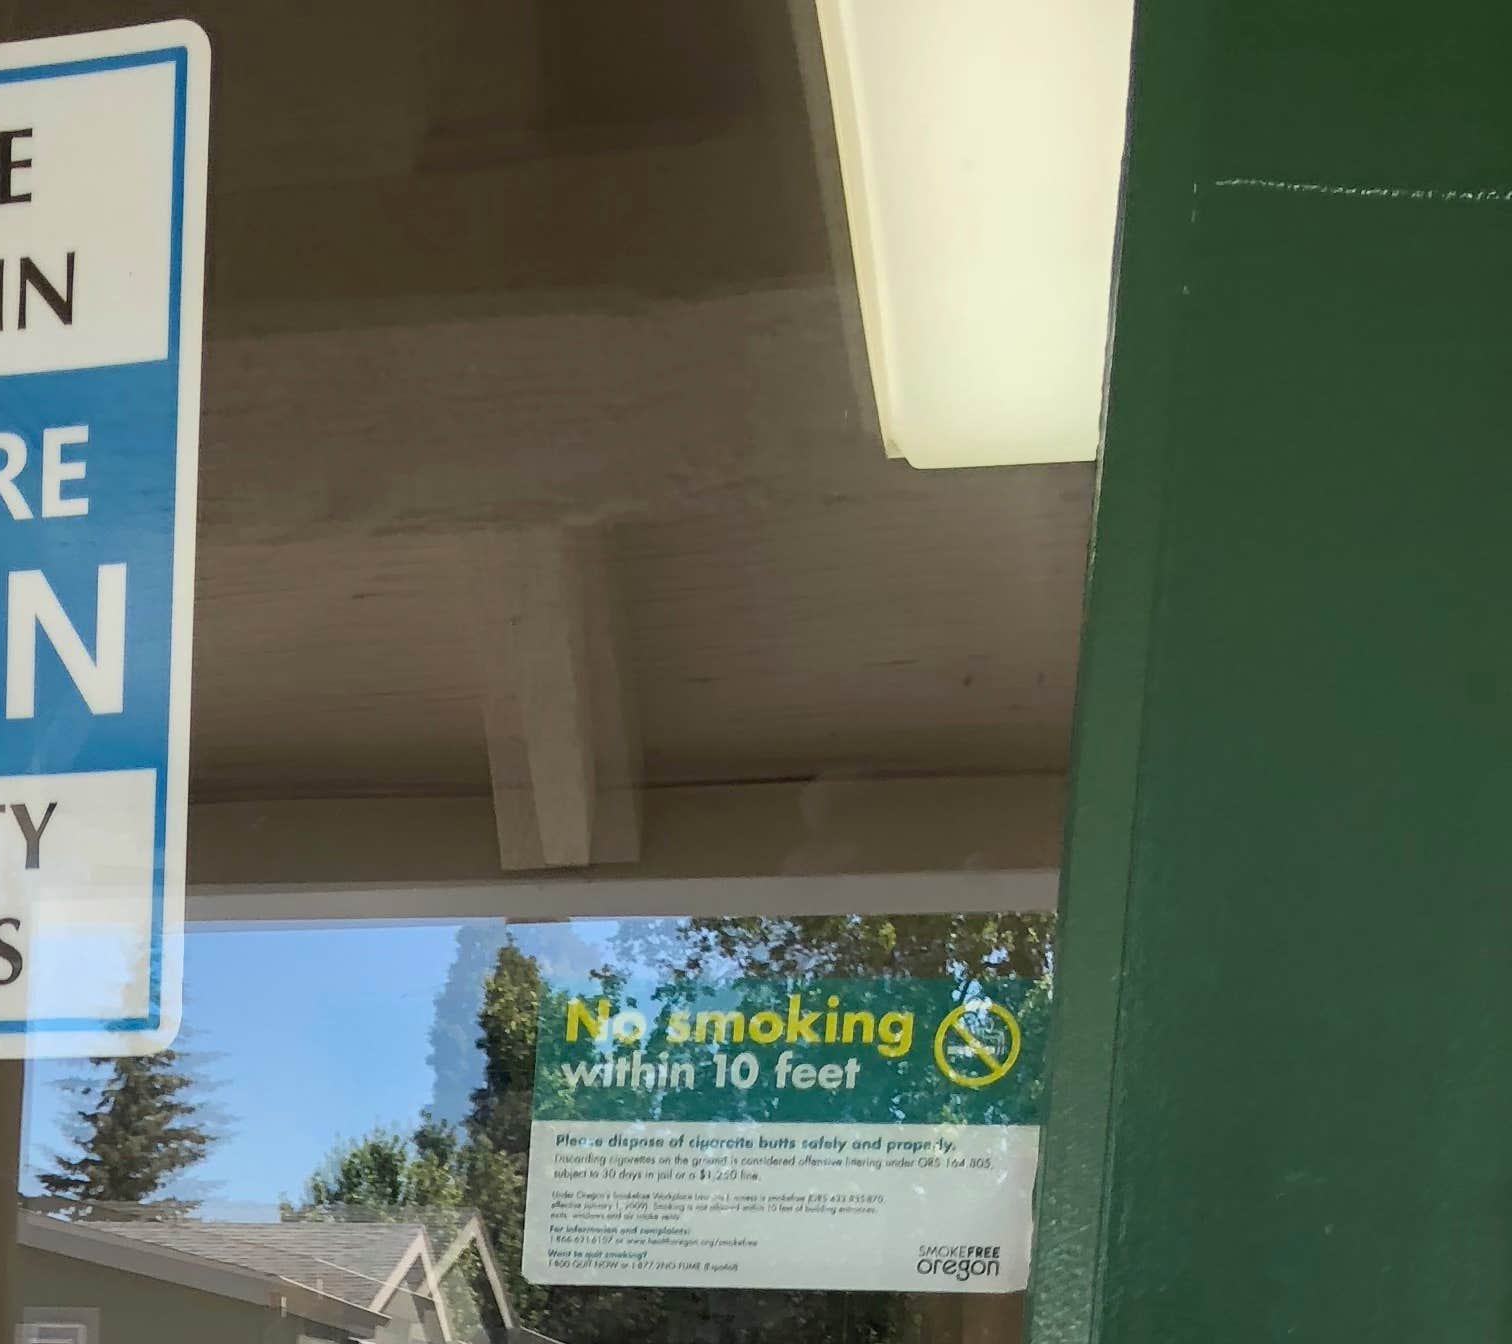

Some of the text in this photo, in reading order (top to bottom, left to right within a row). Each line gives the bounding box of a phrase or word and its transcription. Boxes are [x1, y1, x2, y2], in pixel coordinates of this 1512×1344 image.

[565, 994, 916, 1059] No smoking
[562, 1049, 862, 1091] within 10 feet
[607, 1134, 665, 1151] dispose
[668, 1134, 685, 1149] of
[688, 1134, 754, 1151] cigarette
[758, 1135, 797, 1150] butts
[801, 1136, 847, 1153] safely
[851, 1136, 882, 1150] and
[553, 1152, 607, 1166] Discarding
[609, 1153, 656, 1166] cigarettes
[659, 1156, 671, 1165] on
[674, 1153, 689, 1165] the
[691, 1154, 728, 1167] ground
[730, 1155, 739, 1166] is
[740, 1155, 796, 1167] considered
[798, 1156, 842, 1167] offensive
[885, 1157, 915, 1168] under
[918, 1157, 941, 1169] ORS
[553, 1169, 588, 1182] subject
[589, 1170, 599, 1179] to
[602, 1169, 617, 1179] 30
[618, 1169, 642, 1181] days
[644, 1170, 655, 1179] in
[656, 1170, 673, 1182] jail
[675, 1172, 686, 1180] or
[918, 1245, 1001, 1259] SMOKEFREE
[916, 1259, 1000, 1282] oregon
